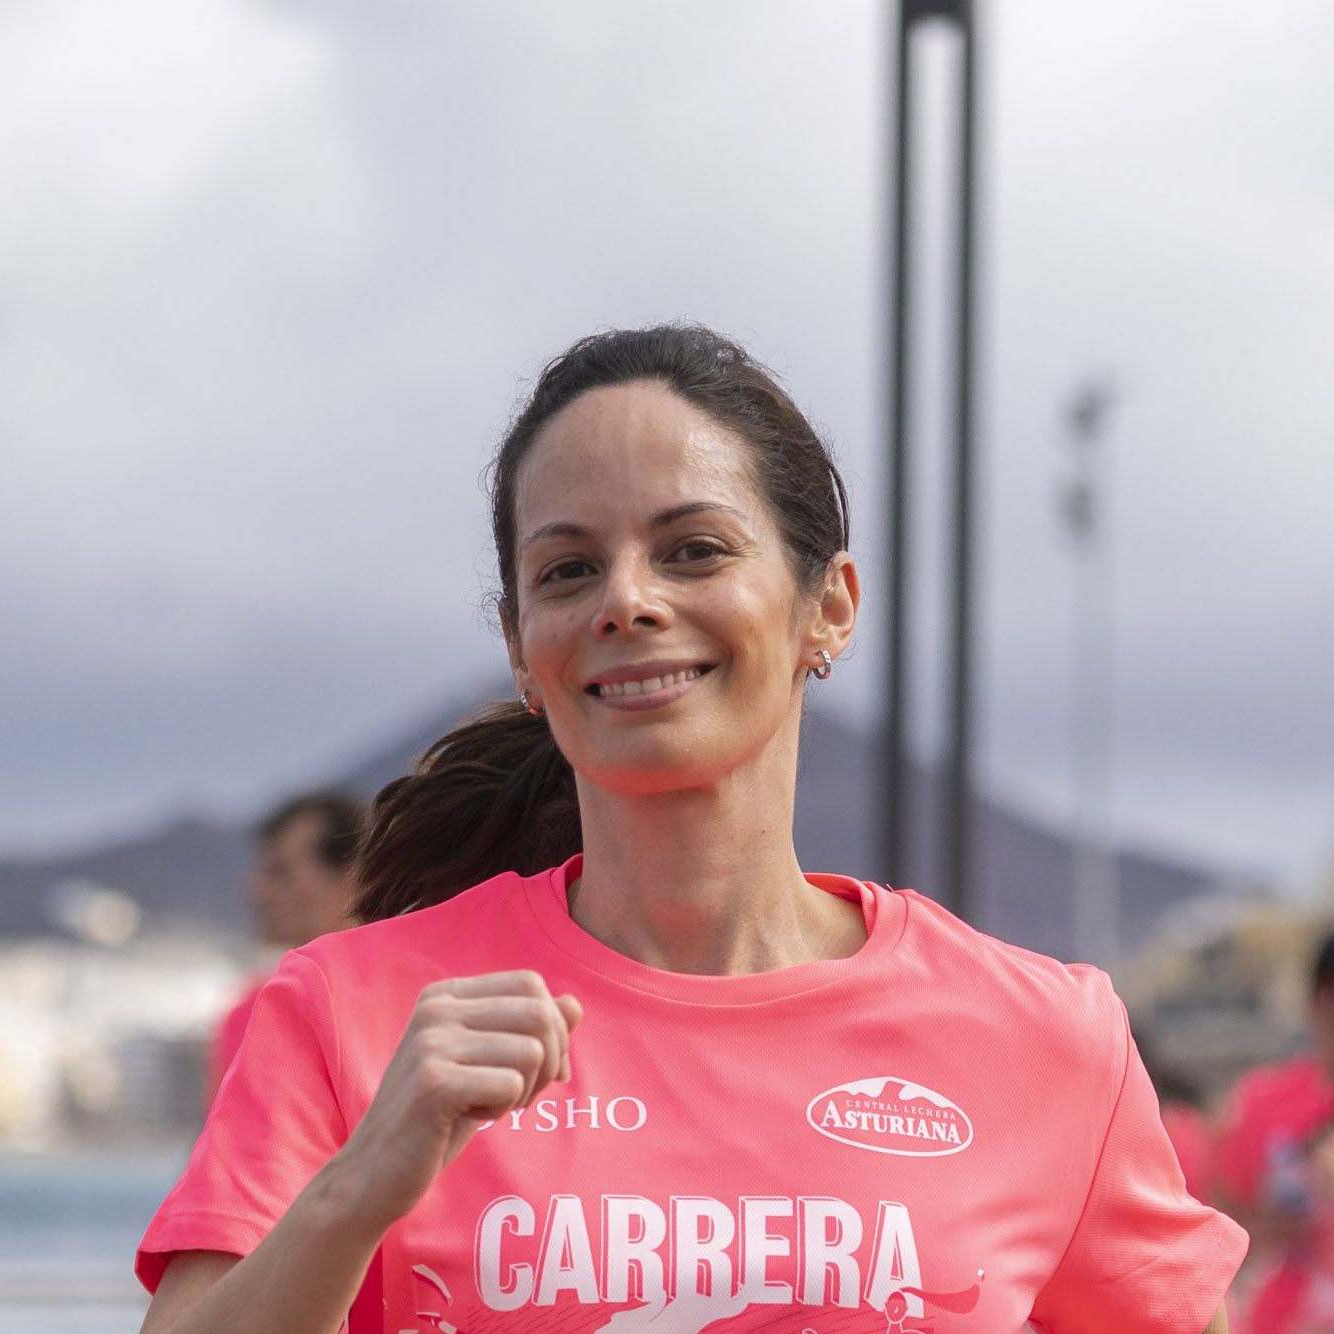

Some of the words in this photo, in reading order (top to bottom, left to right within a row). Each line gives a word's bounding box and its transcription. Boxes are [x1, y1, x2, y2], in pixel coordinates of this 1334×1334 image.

[476, 1095, 648, 1132] YSHO
[820, 1100, 963, 1145] ASTURIANA
[846, 1100, 899, 1112] CENTRAL
[904, 1107, 956, 1121] LECHERA
[473, 1194, 926, 1319] CARRERA
